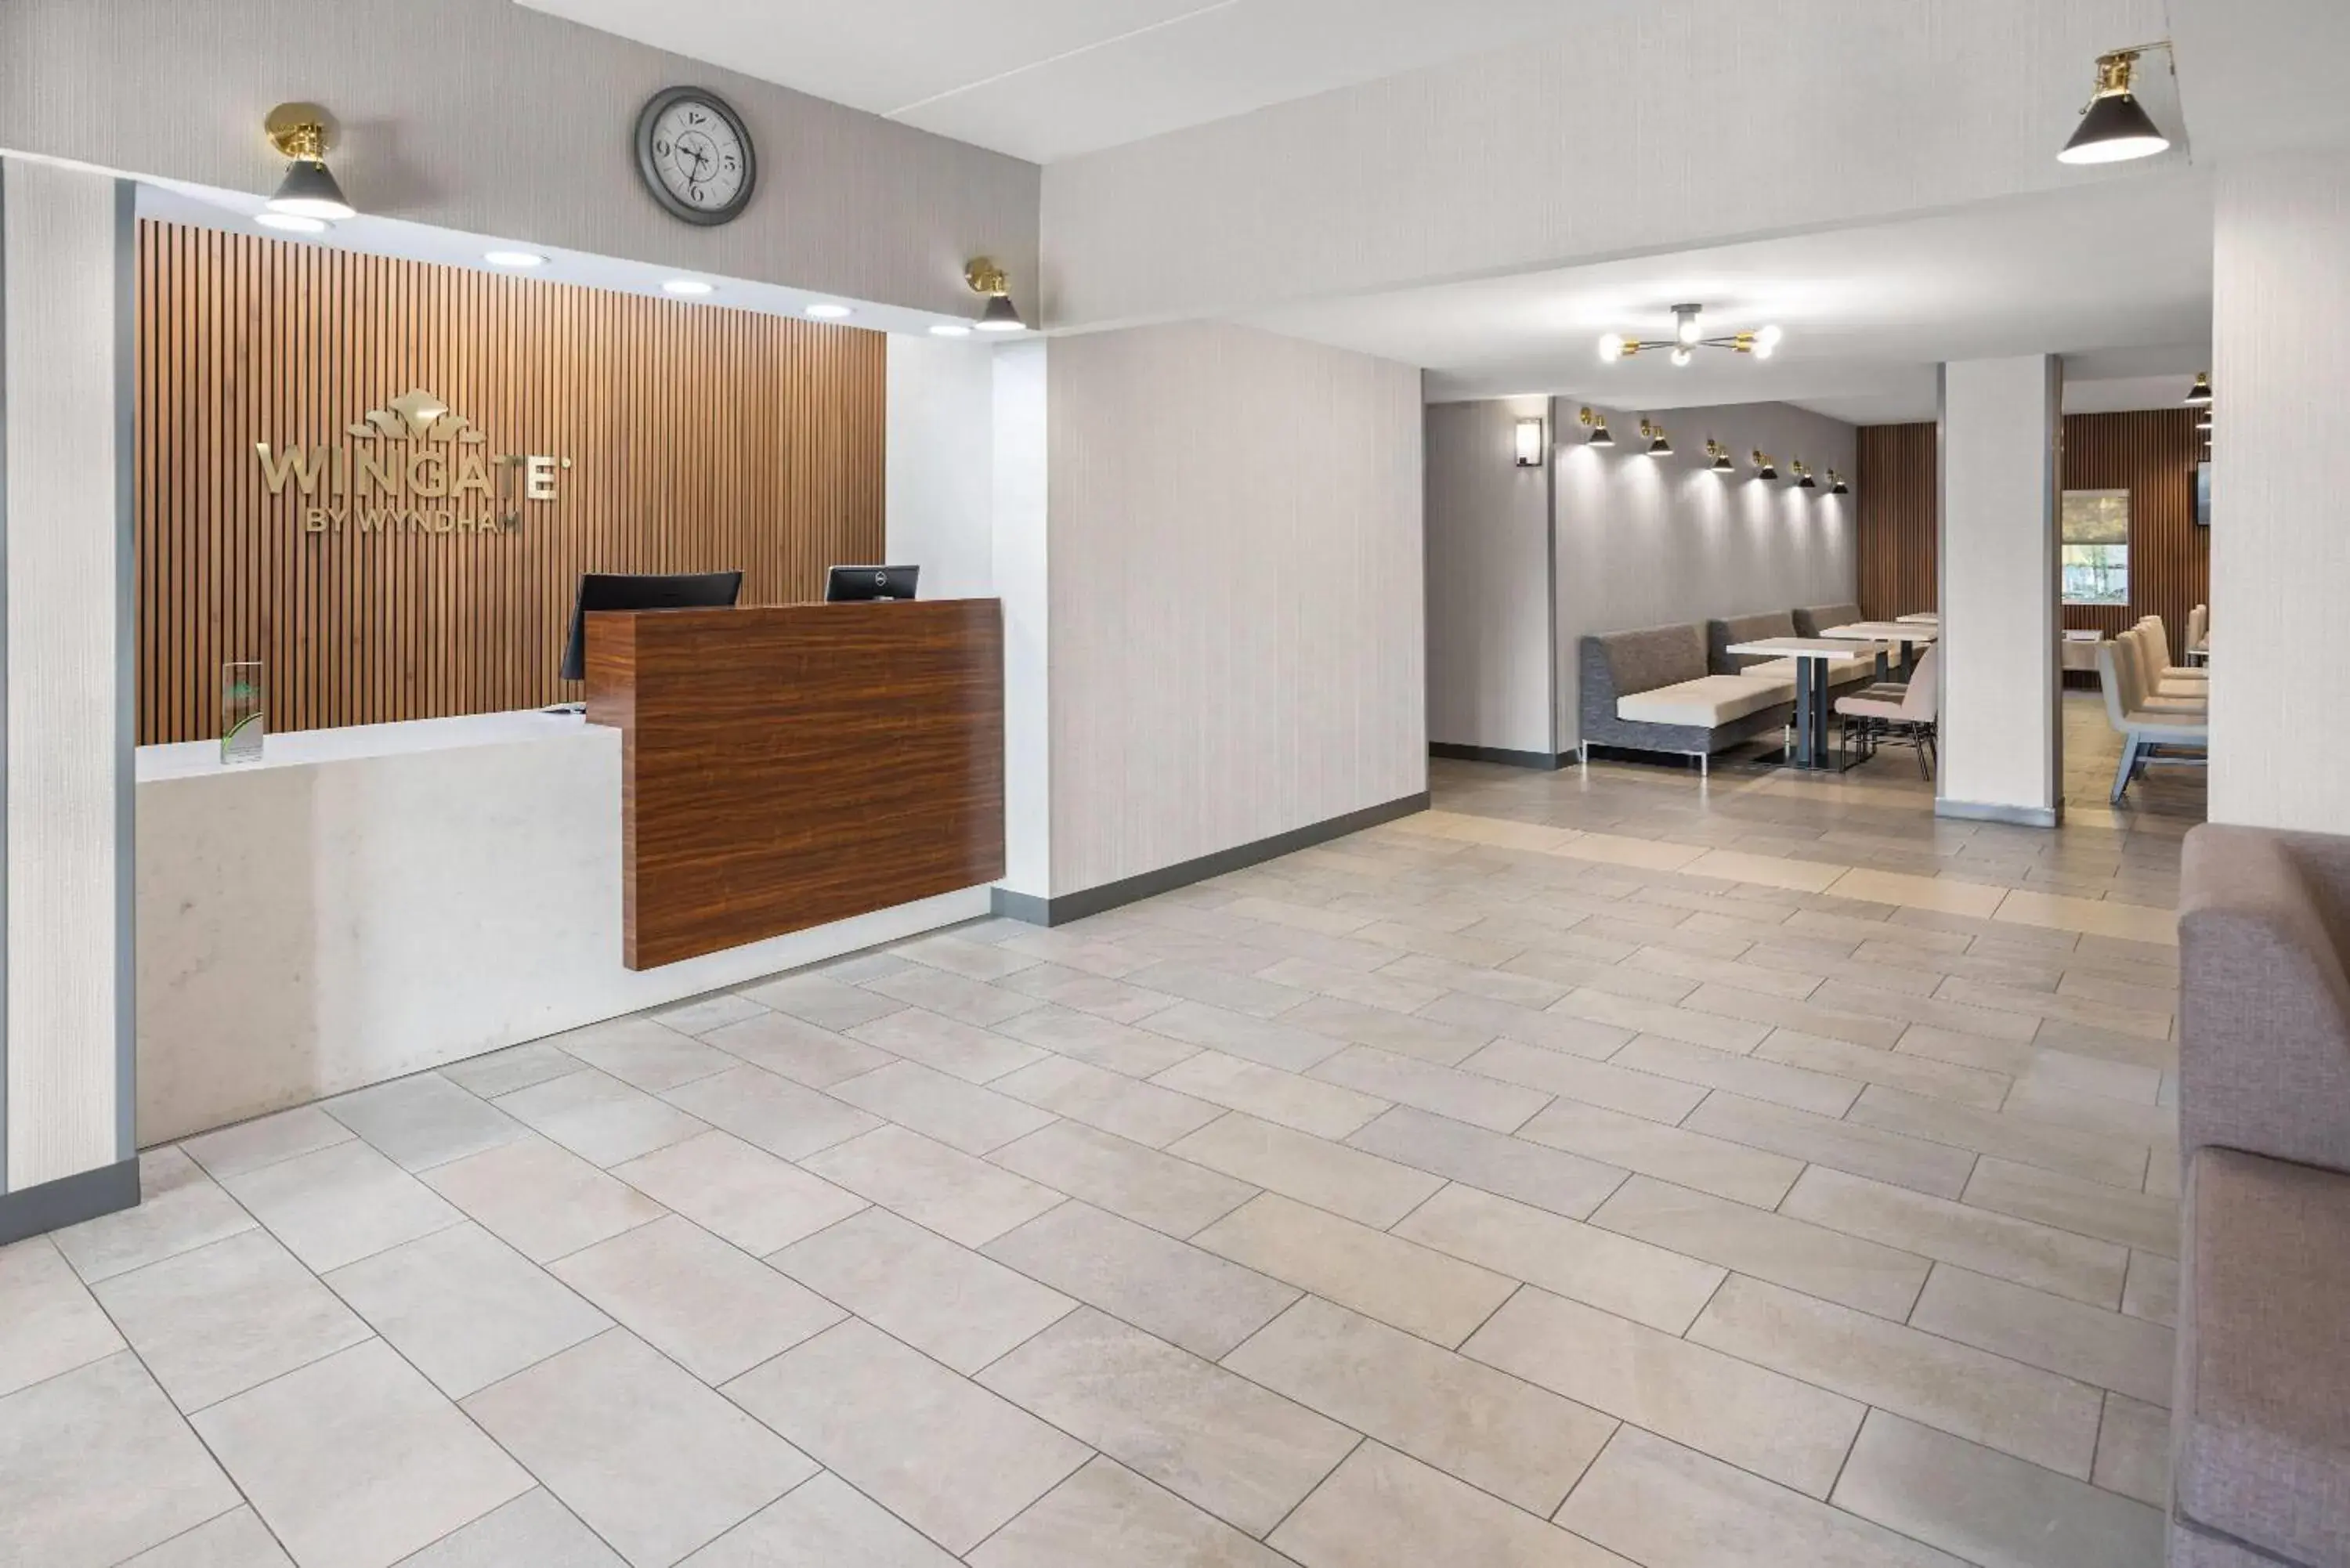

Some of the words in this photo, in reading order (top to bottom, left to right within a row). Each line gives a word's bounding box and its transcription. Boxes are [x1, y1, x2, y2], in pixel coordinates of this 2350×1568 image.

[255, 442, 557, 500] WINGATE
[306, 508, 349, 533] BY
[356, 508, 522, 533] WYNDHAM
